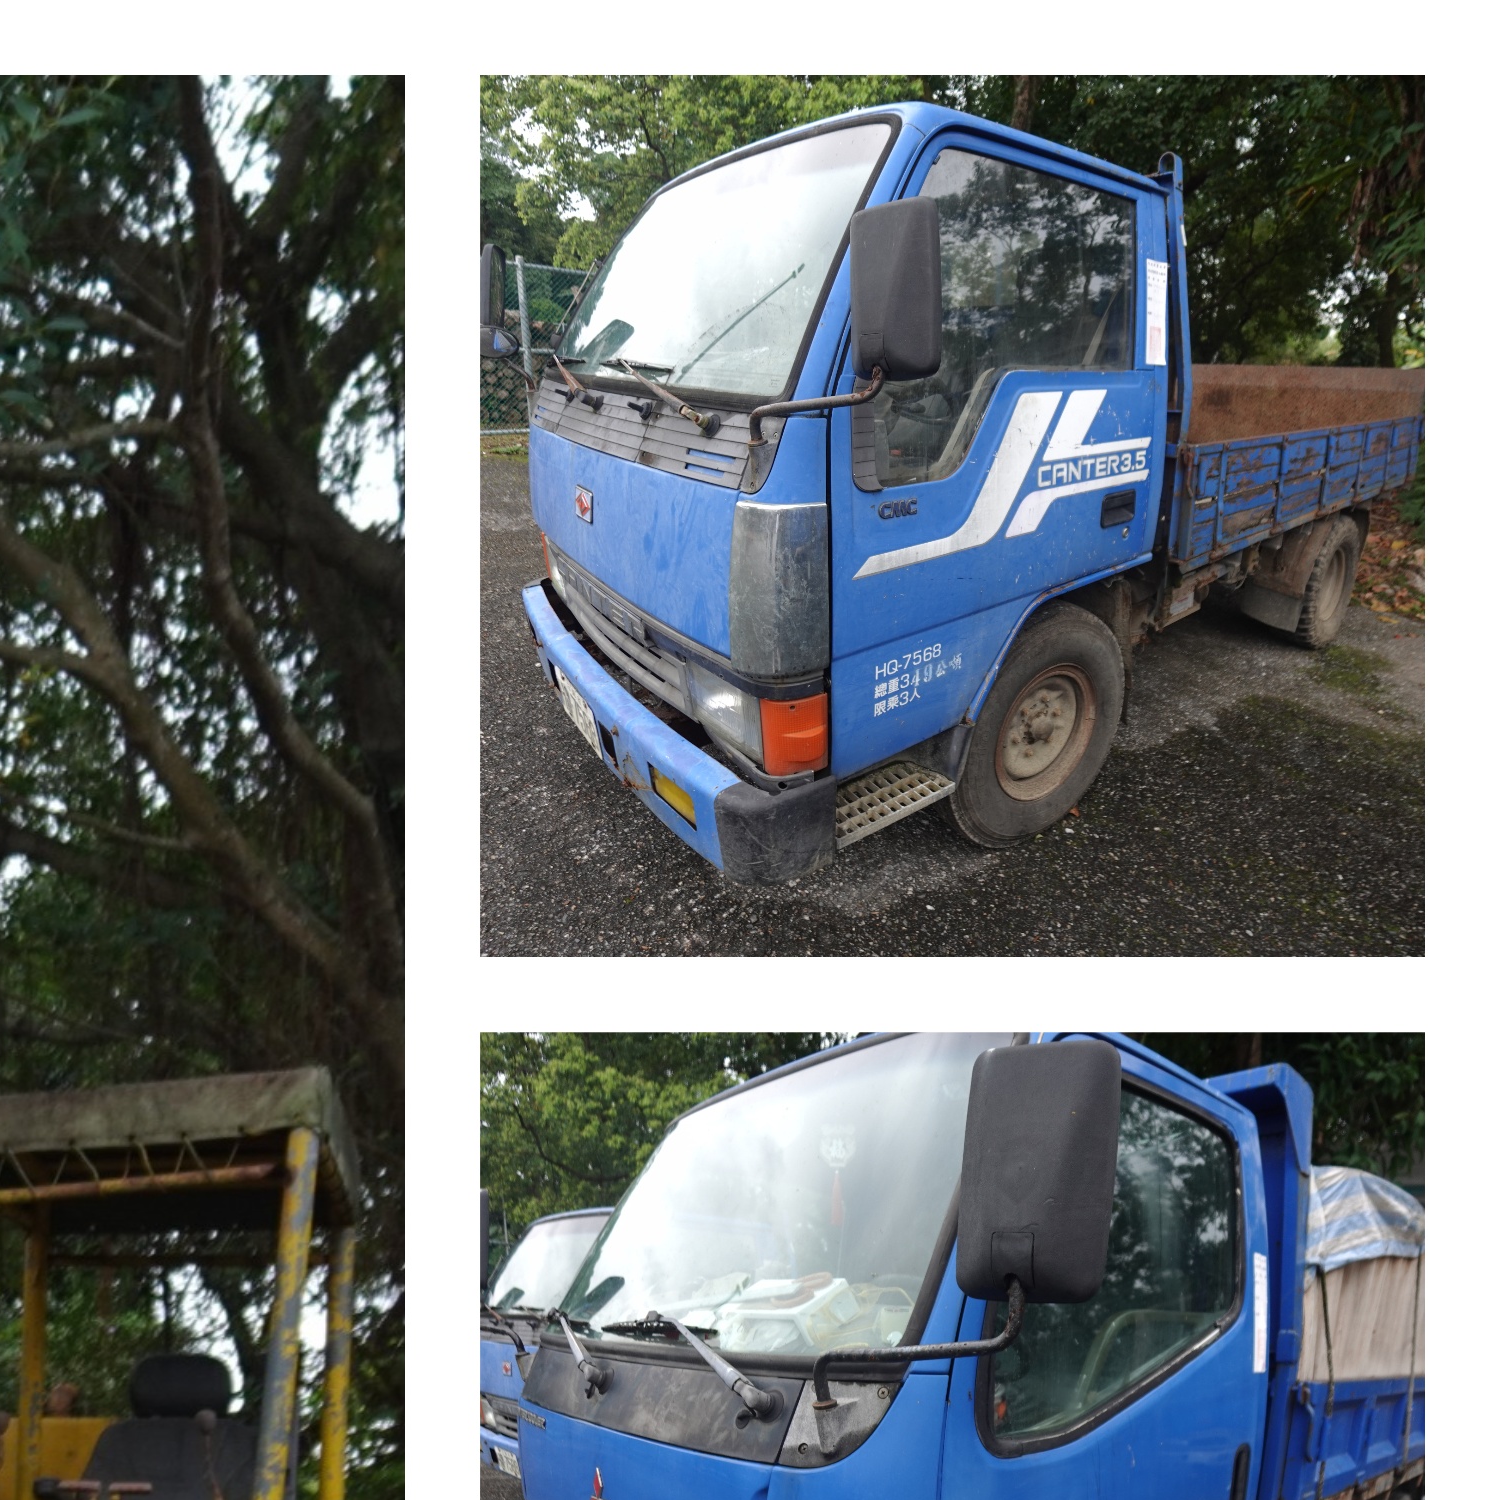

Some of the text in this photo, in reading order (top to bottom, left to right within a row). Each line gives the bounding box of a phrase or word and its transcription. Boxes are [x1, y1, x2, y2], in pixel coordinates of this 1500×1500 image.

[1037, 449, 1147, 489] CANTER3.5
[877, 498, 918, 520] CMC
[875, 643, 942, 681] HQ-7568
[873, 687, 921, 717] 限乘3人
